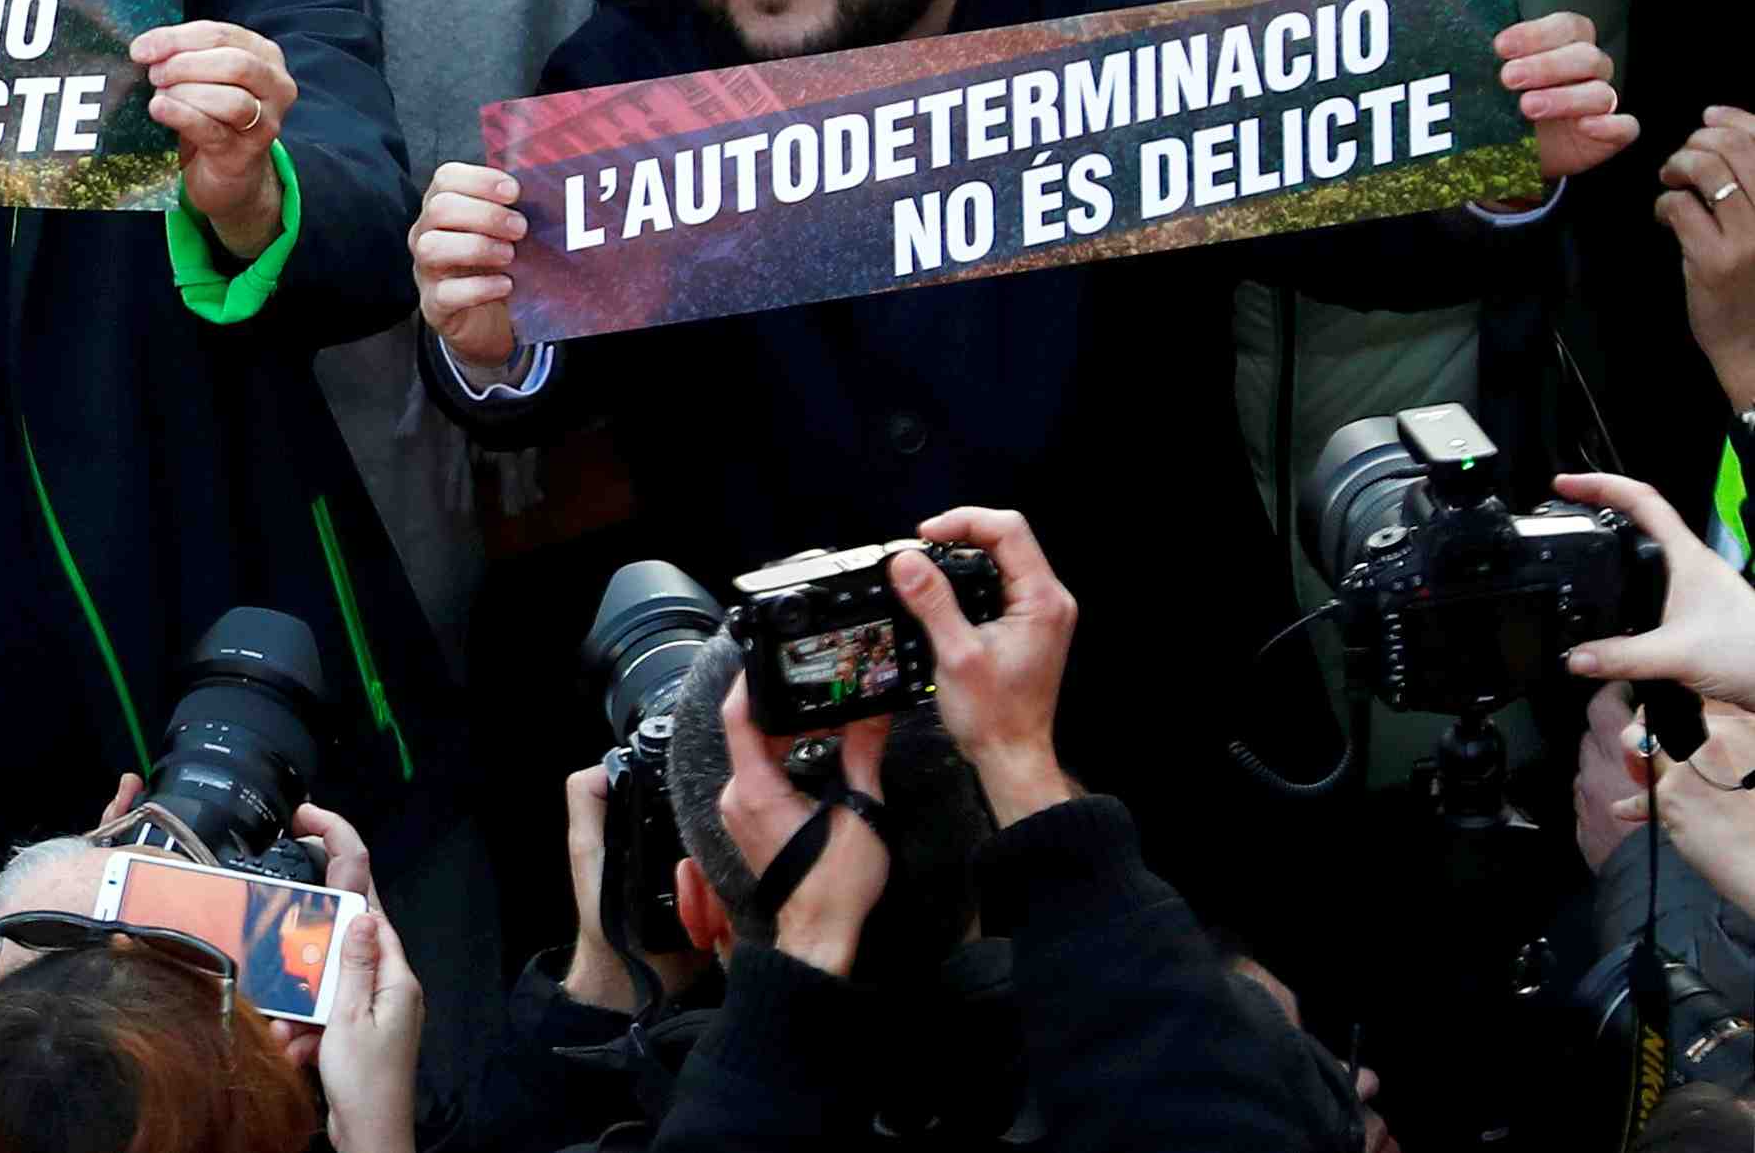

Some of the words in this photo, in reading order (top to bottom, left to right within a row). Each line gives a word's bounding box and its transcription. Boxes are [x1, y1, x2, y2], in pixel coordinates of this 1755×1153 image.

[893, 183, 994, 277] NO
[1021, 153, 1113, 247] ÉS
[1140, 73, 1452, 220] DELICTE
